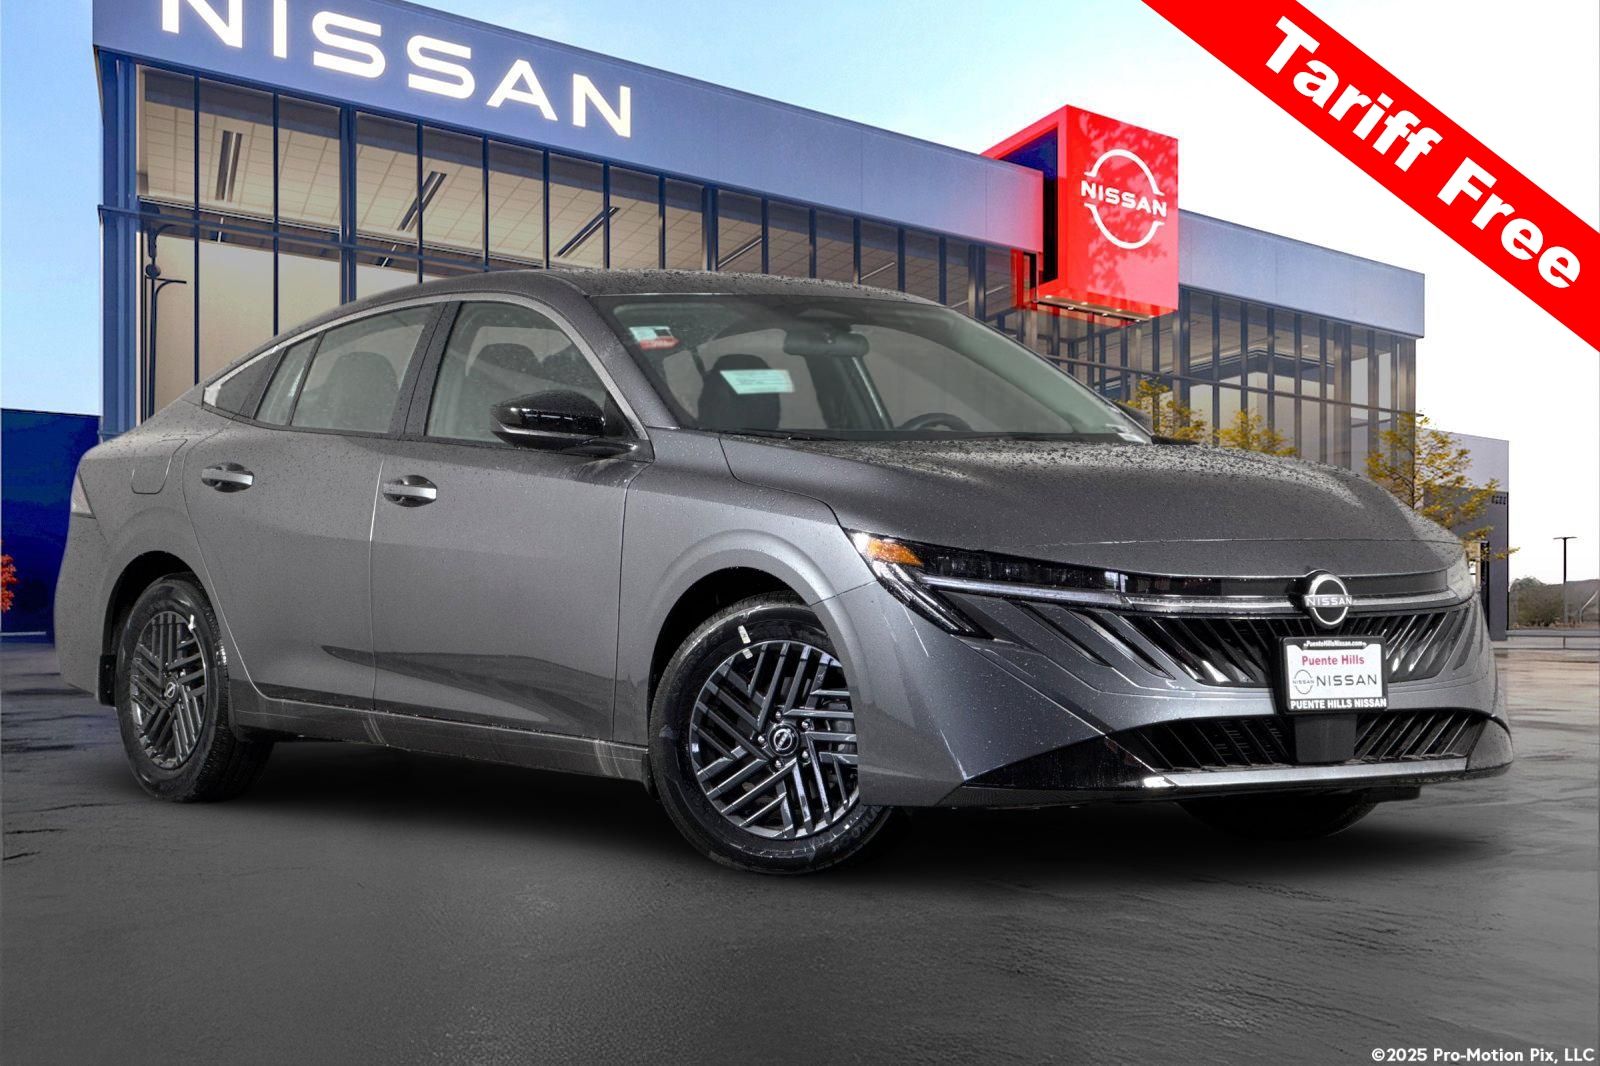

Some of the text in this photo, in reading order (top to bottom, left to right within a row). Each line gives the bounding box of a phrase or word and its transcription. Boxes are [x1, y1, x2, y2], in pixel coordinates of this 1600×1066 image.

[162, 0, 631, 139] NISSAN
[1081, 180, 1167, 217] NISSAN
[1305, 597, 1353, 607] NISSAN
[1301, 654, 1365, 666] Puente Hills
[1316, 674, 1378, 687] NISSAN
[1290, 698, 1387, 710] PUENTE HILLS NISSAN
